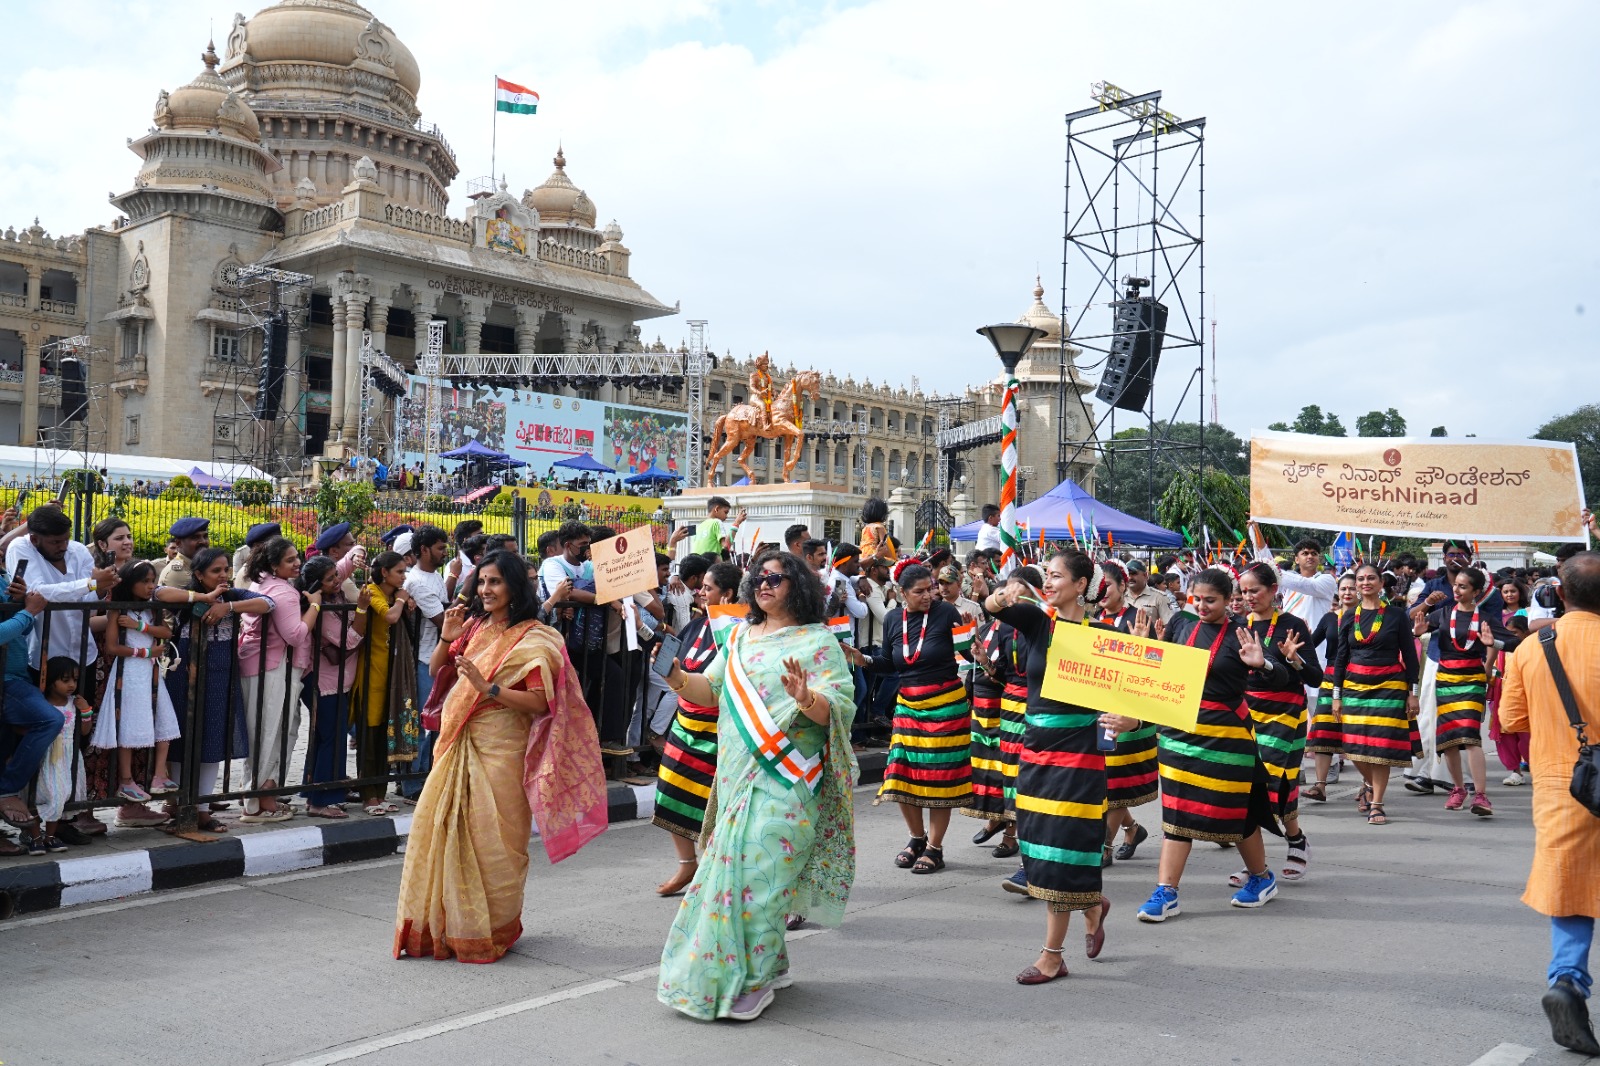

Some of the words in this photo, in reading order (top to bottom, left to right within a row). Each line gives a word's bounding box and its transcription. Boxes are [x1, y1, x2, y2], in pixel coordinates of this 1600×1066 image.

[428, 279, 489, 298] GOVERNMENT
[493, 291, 515, 304] WORK
[1340, 463, 1402, 483] ನಿನಾದ್
[1415, 466, 1530, 487] ಫೌಂಡೇಶನ್
[1322, 482, 1477, 505] SparshNinaad
[1396, 510, 1412, 519] Art,
[1416, 510, 1448, 520] Culture
[1058, 659, 1092, 677] NORTH
[1094, 666, 1120, 683] EAST
